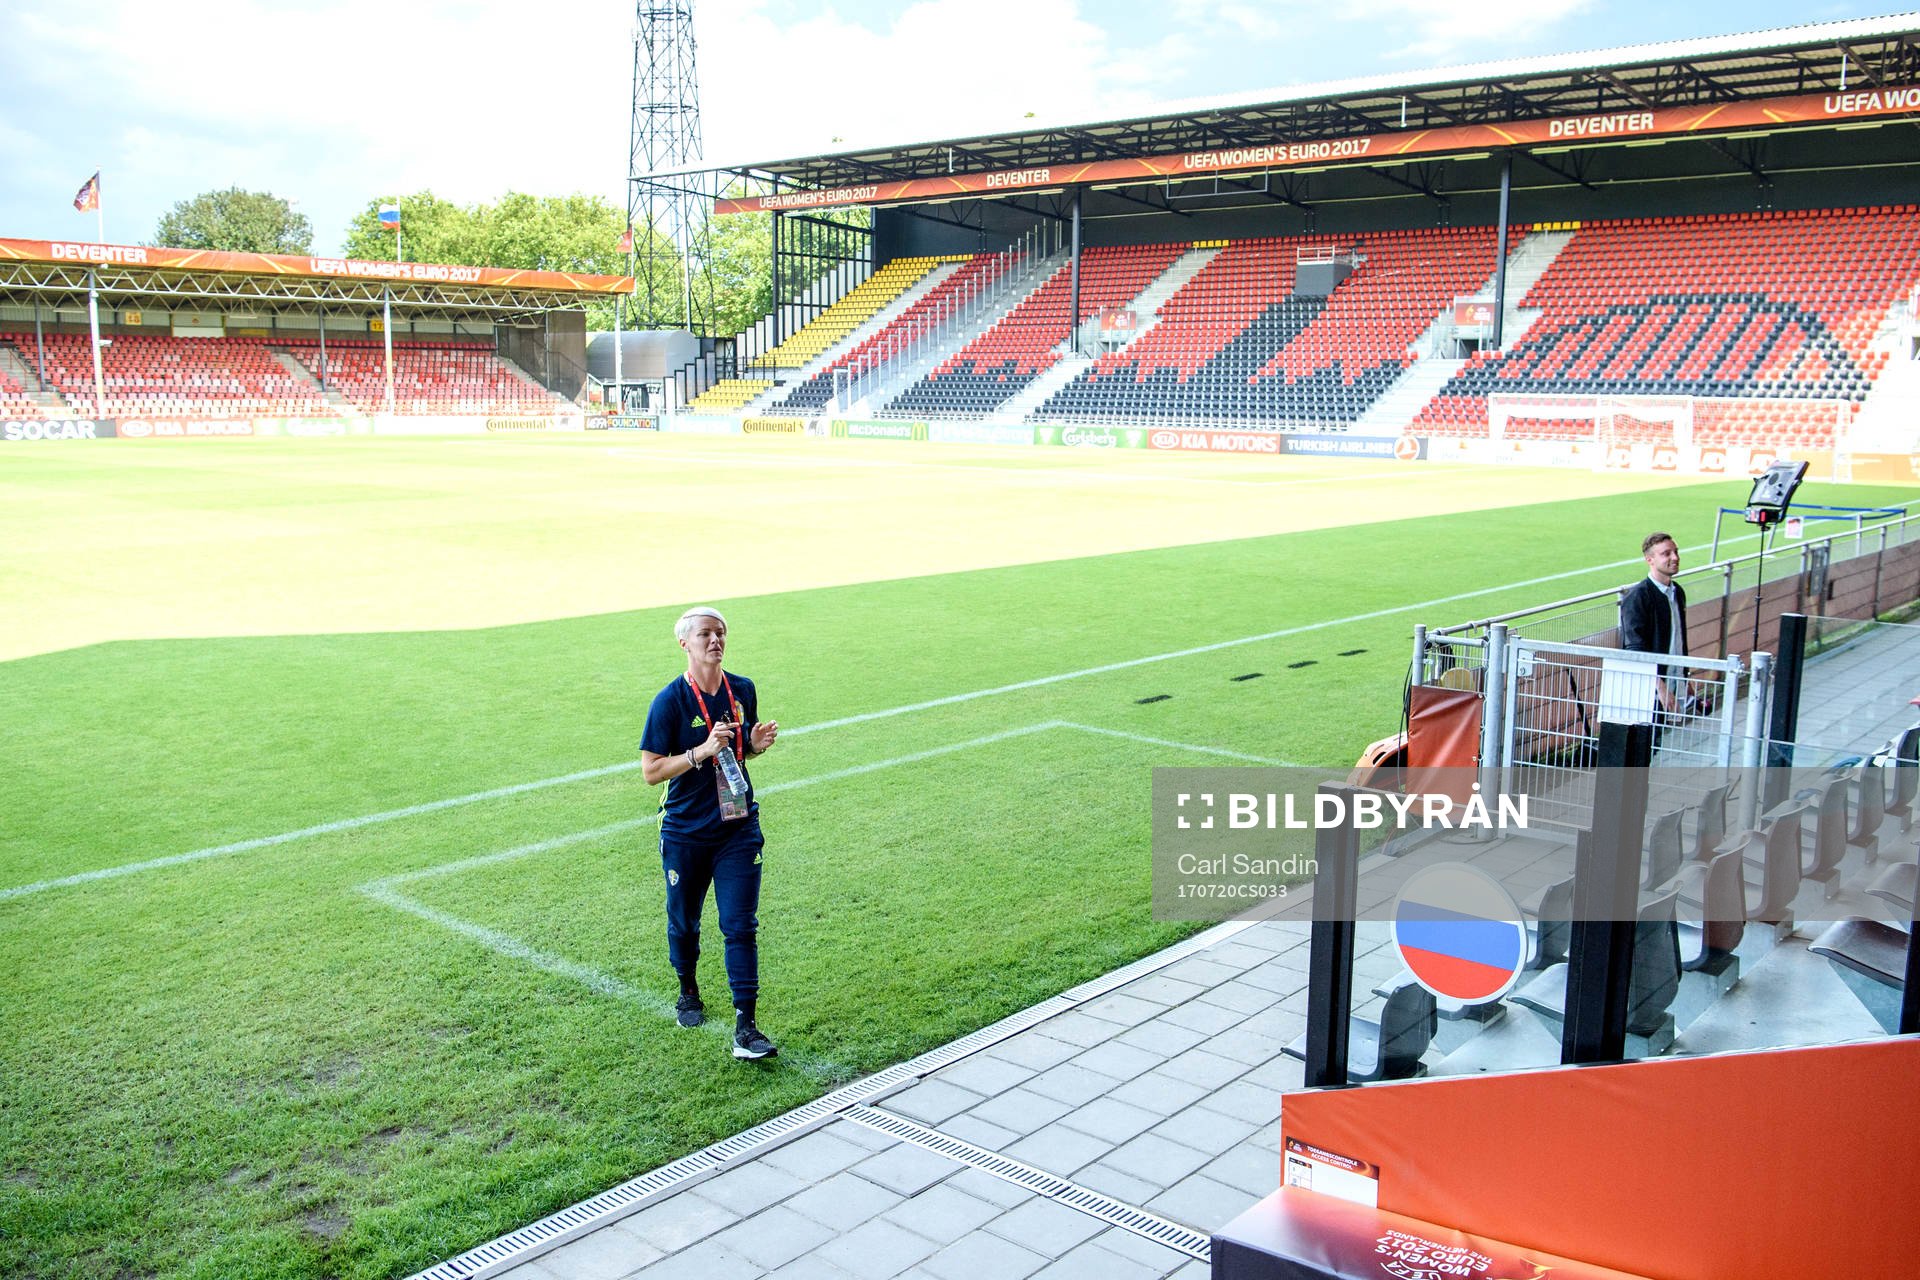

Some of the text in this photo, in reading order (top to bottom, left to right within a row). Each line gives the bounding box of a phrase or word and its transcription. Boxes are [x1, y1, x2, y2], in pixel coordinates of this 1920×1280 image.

[1824, 92, 1882, 114] UEFA
[1549, 113, 1654, 138] DEVENTER
[1184, 138, 1370, 169] UEFA WOMEN'S EURO 2017
[986, 169, 1050, 187] DEVENTER
[759, 186, 878, 208] UEFA WOMEN'S EURO 2017
[51, 243, 148, 264] DEVENTER
[310, 259, 481, 282] UEFA WOMEN'S EURO 2017
[5, 420, 97, 440] SOCAR
[486, 418, 547, 432] Continental
[608, 416, 656, 429] FOUNDATION
[743, 419, 796, 434] Continental
[848, 424, 912, 438] McDonald's
[1182, 433, 1208, 449] KIA
[1211, 435, 1278, 452] MOTORS
[1288, 439, 1394, 454] TURKISH AIRLINES
[1376, 1236, 1489, 1272] EURO 2017
[1385, 1229, 1493, 1265] THE NETHERLANDS
[1374, 1244, 1471, 1277] WOMEN'S
